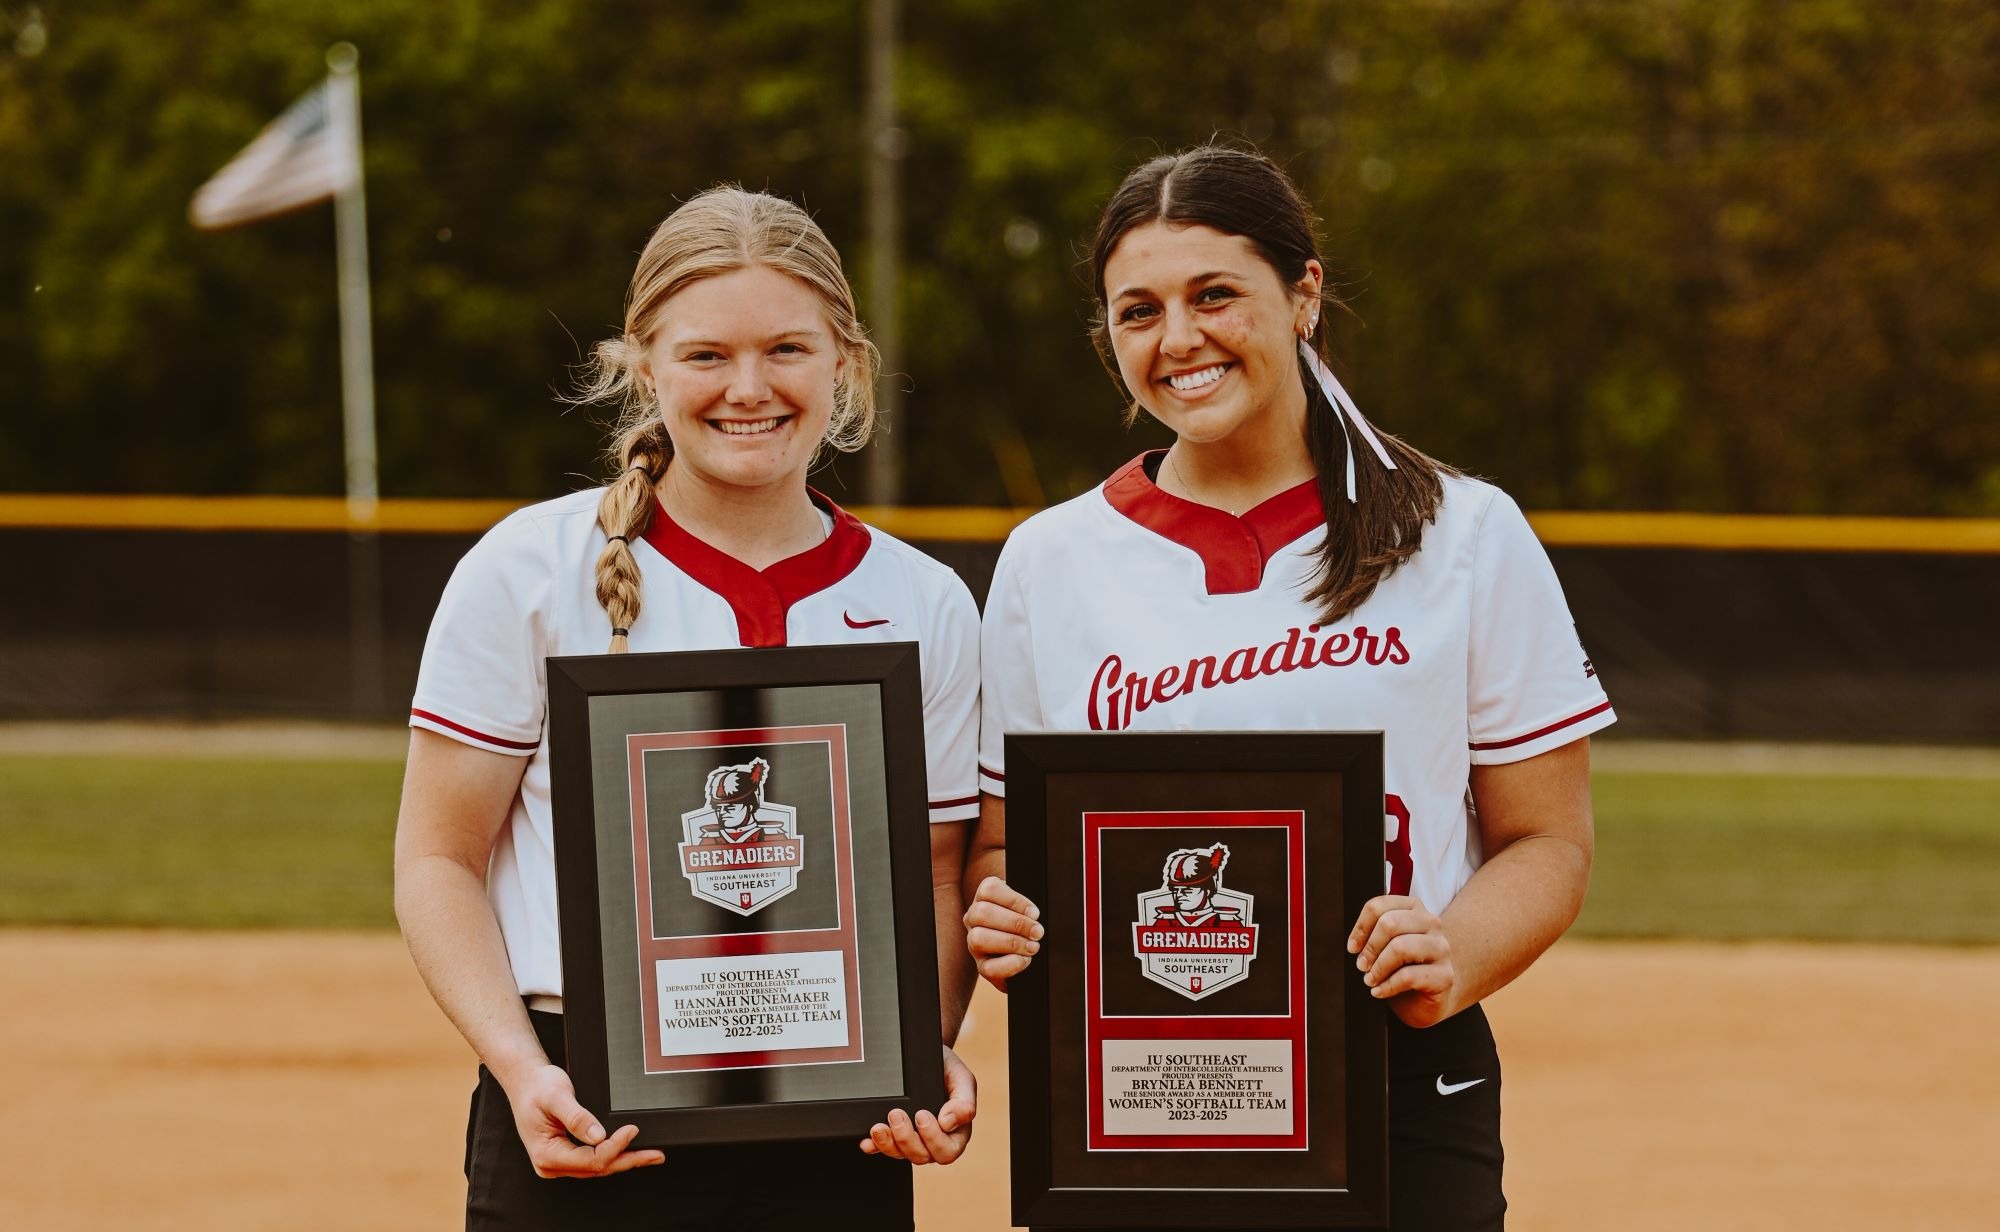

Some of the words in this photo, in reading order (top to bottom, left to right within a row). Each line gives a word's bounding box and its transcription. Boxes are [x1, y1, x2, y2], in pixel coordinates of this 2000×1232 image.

[1087, 623, 1411, 731] Grenadiers
[689, 846, 796, 867] GRENADIERS
[739, 872, 782, 880] UNIVERSITY
[713, 880, 776, 891] SOUTHEAST
[1142, 932, 1249, 949] GRENADIERS
[701, 972, 716, 983] IU
[719, 968, 800, 982] SOUTHEAST
[1164, 965, 1228, 974] SOUTHEAST
[666, 984, 715, 992] DEPARTMENT
[728, 980, 796, 989] INTERCOLLEGIATE
[675, 997, 736, 1009] HANNAH
[740, 992, 830, 1006] NUNEMAKER
[665, 1016, 729, 1029] WOMEN'S
[732, 1012, 799, 1026] SOFTBALL
[802, 1010, 841, 1022] TEAM
[725, 1025, 783, 1038] 2022-2025
[1147, 1055, 1162, 1065] IU
[1166, 1055, 1247, 1065] SOUTHEAST
[1132, 1080, 1195, 1090] BRYNLEA
[1199, 1080, 1263, 1090] BENNETT
[1109, 1098, 1173, 1109] WOMEN'S
[1176, 1099, 1244, 1109] SOFTBALL
[1247, 1099, 1286, 1109] TEAM
[1168, 1110, 1228, 1120] 2023-2025
